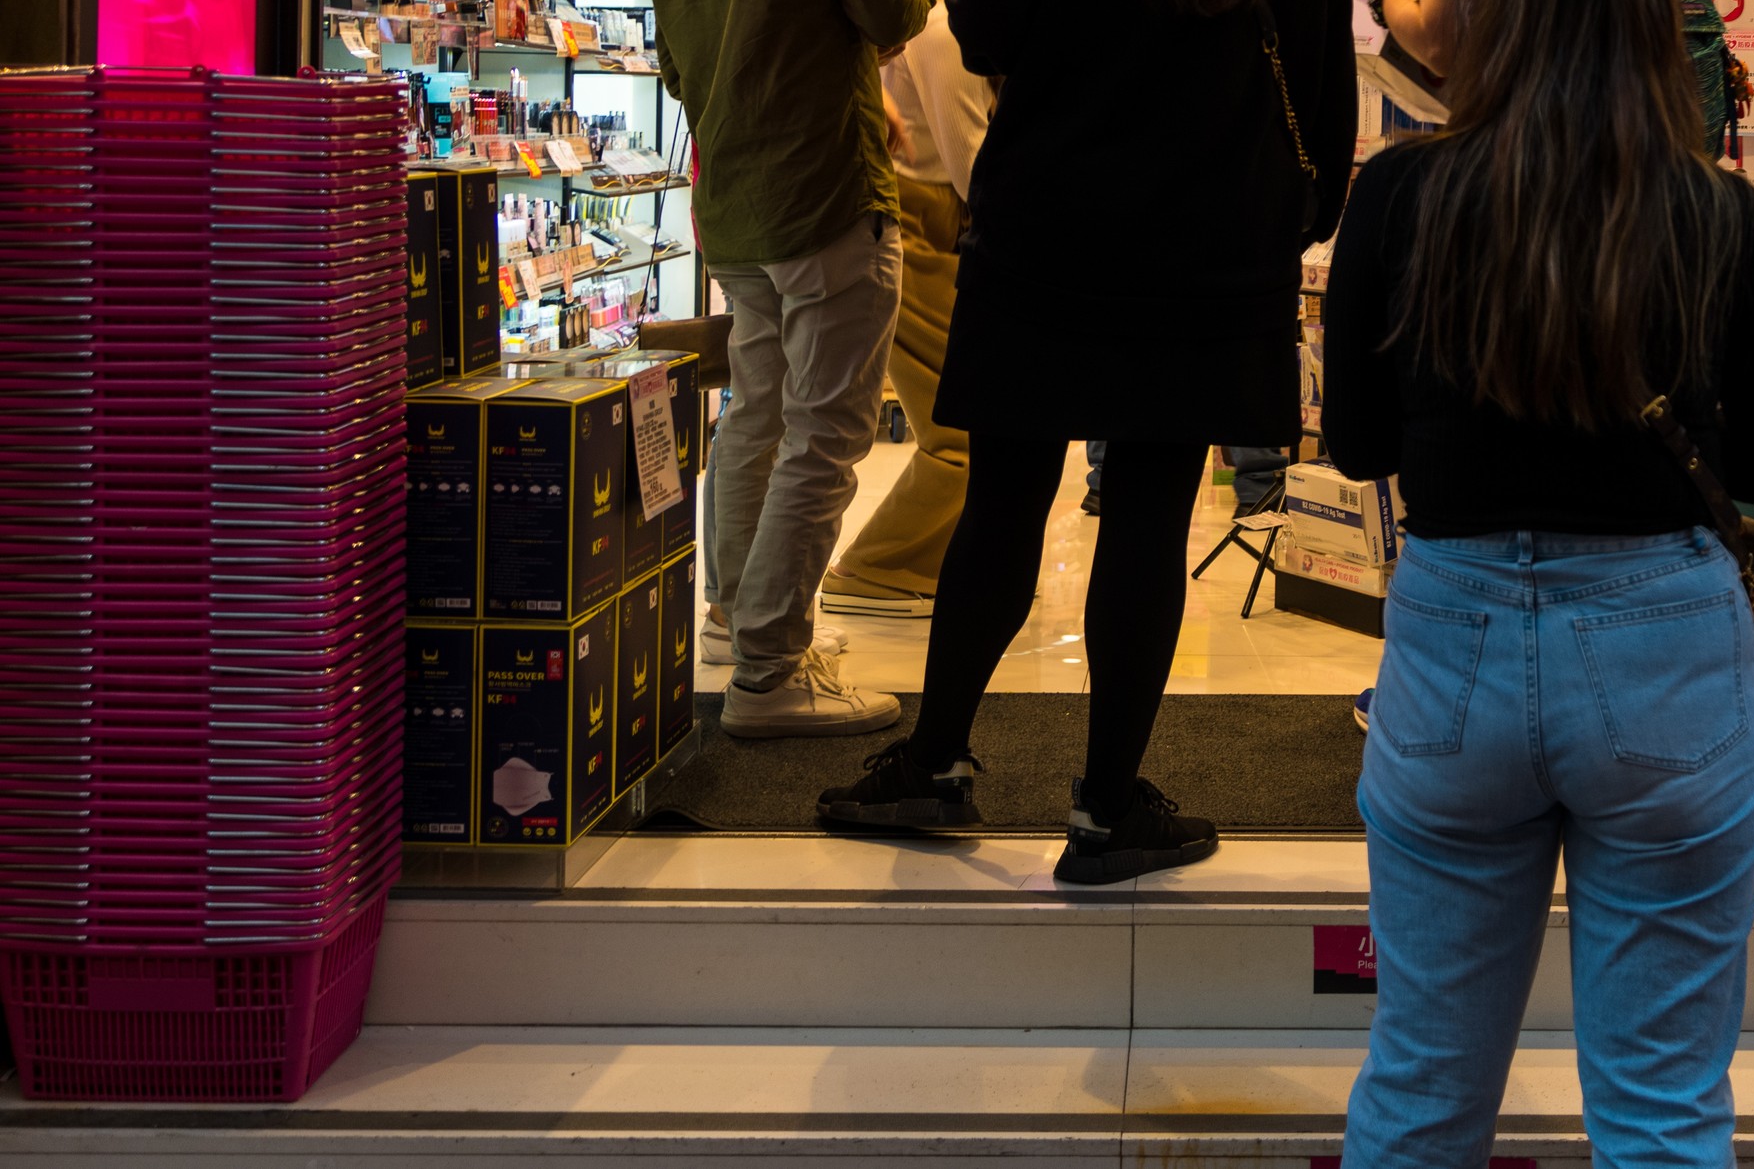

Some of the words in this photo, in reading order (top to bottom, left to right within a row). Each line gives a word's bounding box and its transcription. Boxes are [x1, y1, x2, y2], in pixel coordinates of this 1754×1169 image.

[1309, 502, 1329, 515] COVID-19
[487, 671, 515, 681] PASS
[516, 671, 545, 681] OVER
